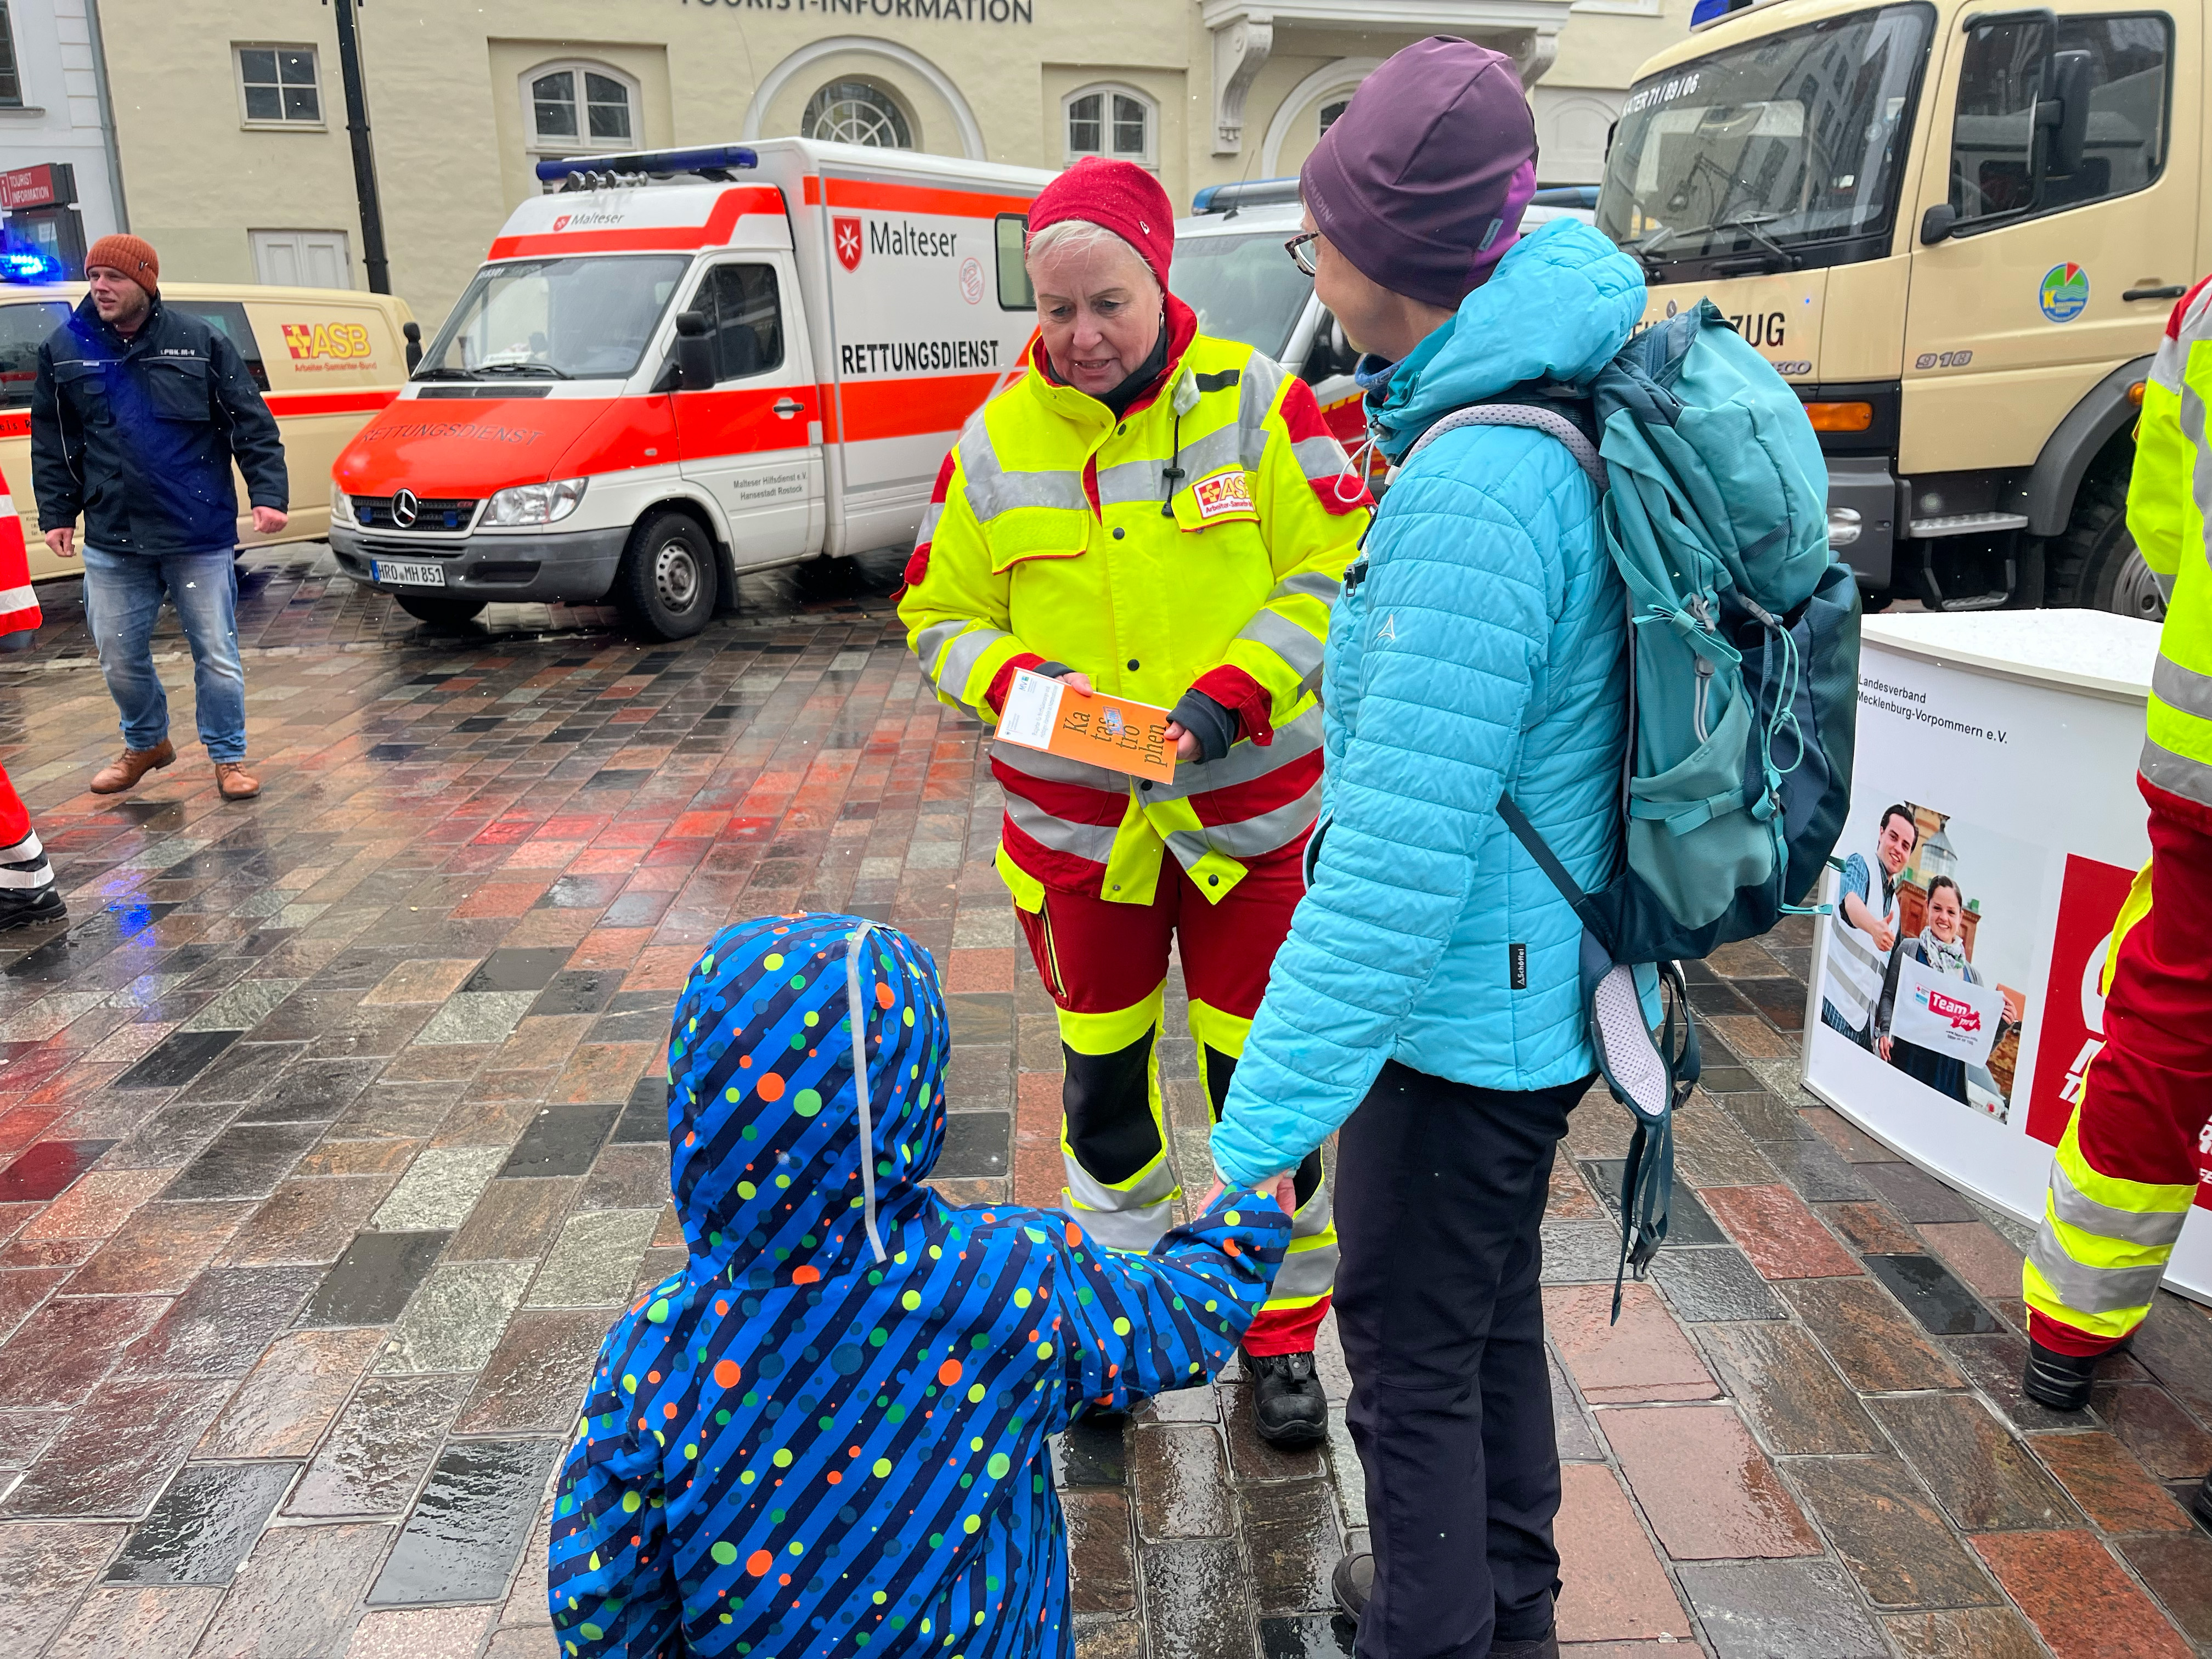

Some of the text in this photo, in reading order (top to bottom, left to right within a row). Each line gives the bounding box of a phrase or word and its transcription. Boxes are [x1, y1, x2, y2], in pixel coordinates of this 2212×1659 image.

[682, 0, 1032, 23] T-INFORMATION
[9, 172, 32, 188] TOURIST
[12, 185, 49, 204] INFORMATION
[571, 212, 625, 225] Malteser
[870, 220, 957, 257] Malteser
[311, 322, 372, 360] ASB
[842, 340, 999, 374] RETTUNGSDIENST
[1770, 360, 1813, 375] ECO
[1915, 349, 1973, 369] 918
[364, 423, 545, 445] RETTUNGSDIENST
[733, 479, 761, 489] Malteser
[741, 484, 803, 500] Hansestadt Rostock
[1220, 475, 1250, 501] AS
[377, 563, 444, 583] HRO MH 851
[1859, 673, 1926, 703] Landesverband
[1063, 712, 1090, 735] Ka
[1858, 690, 2007, 743] Mecklenburg-Vorpommern e.V.
[1116, 725, 1140, 749] tro
[1138, 724, 1167, 768] phen
[1933, 994, 1968, 1015] Team
